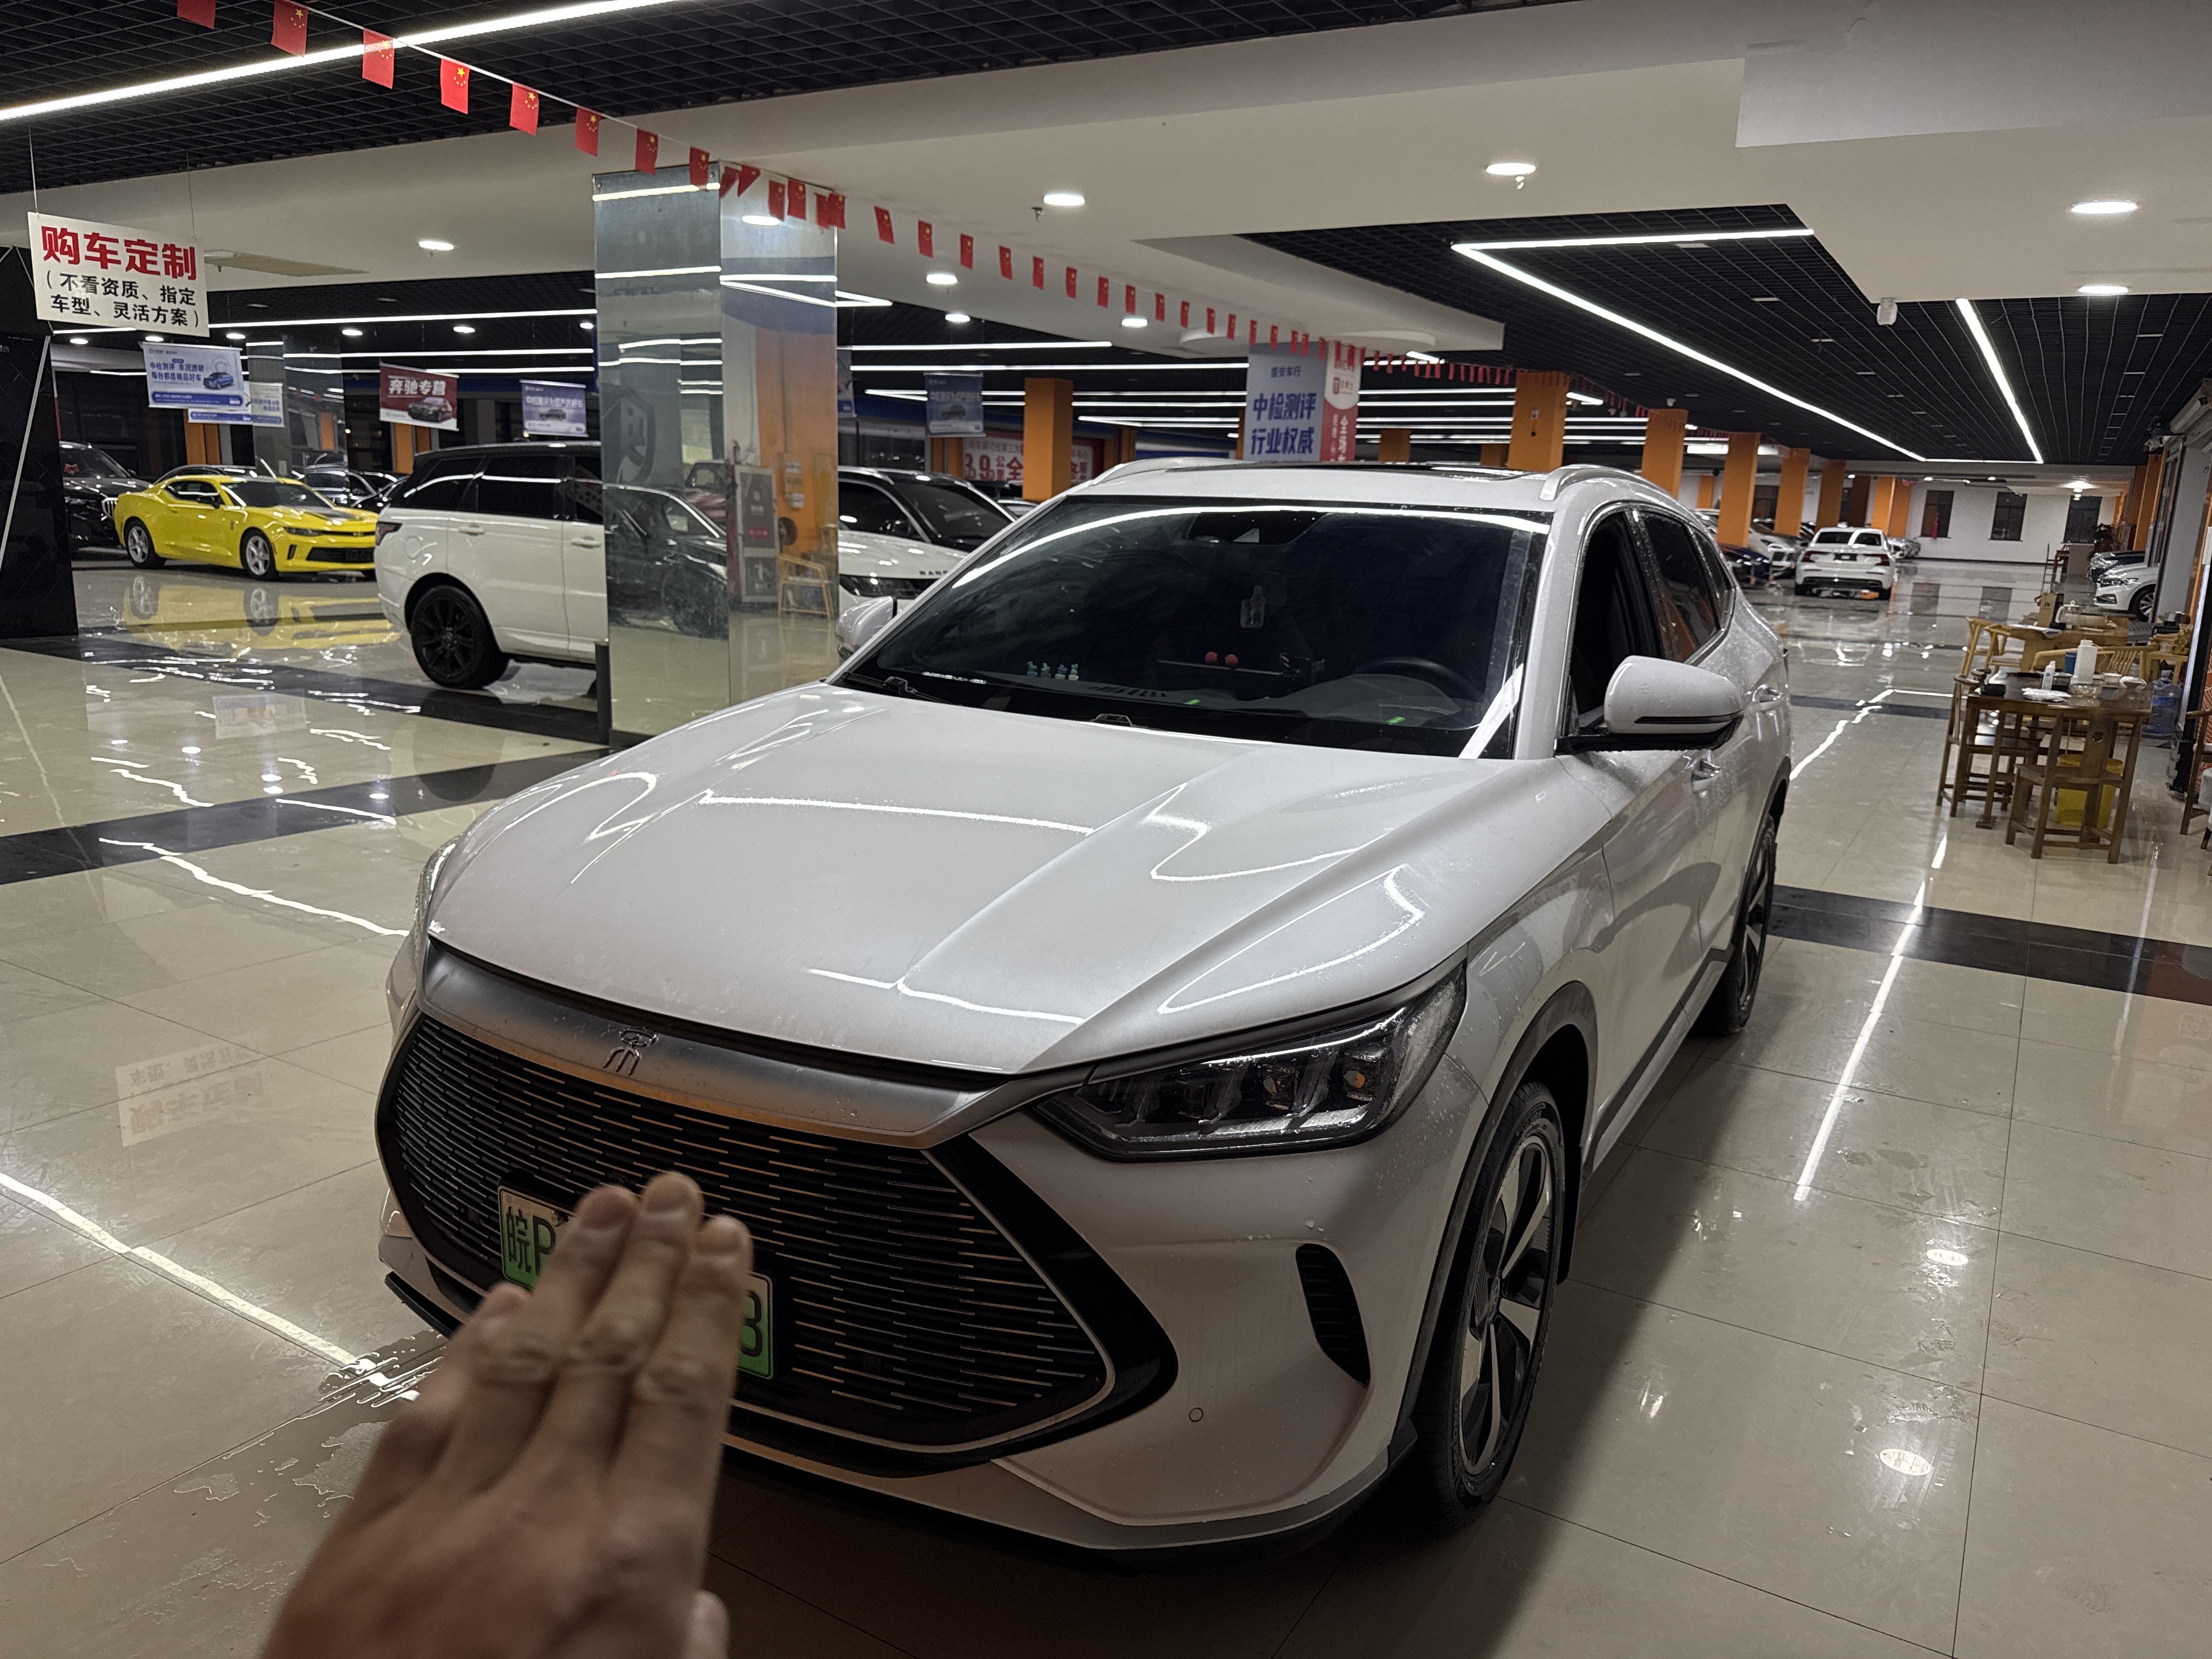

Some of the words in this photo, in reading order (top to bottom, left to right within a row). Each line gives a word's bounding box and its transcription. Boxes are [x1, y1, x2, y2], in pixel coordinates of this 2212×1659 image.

[41, 226, 196, 280] 购车定制
[388, 379, 446, 396] 奔驰专营
[1253, 393, 1317, 421] 中检测评
[1250, 427, 1315, 455] 行业权威
